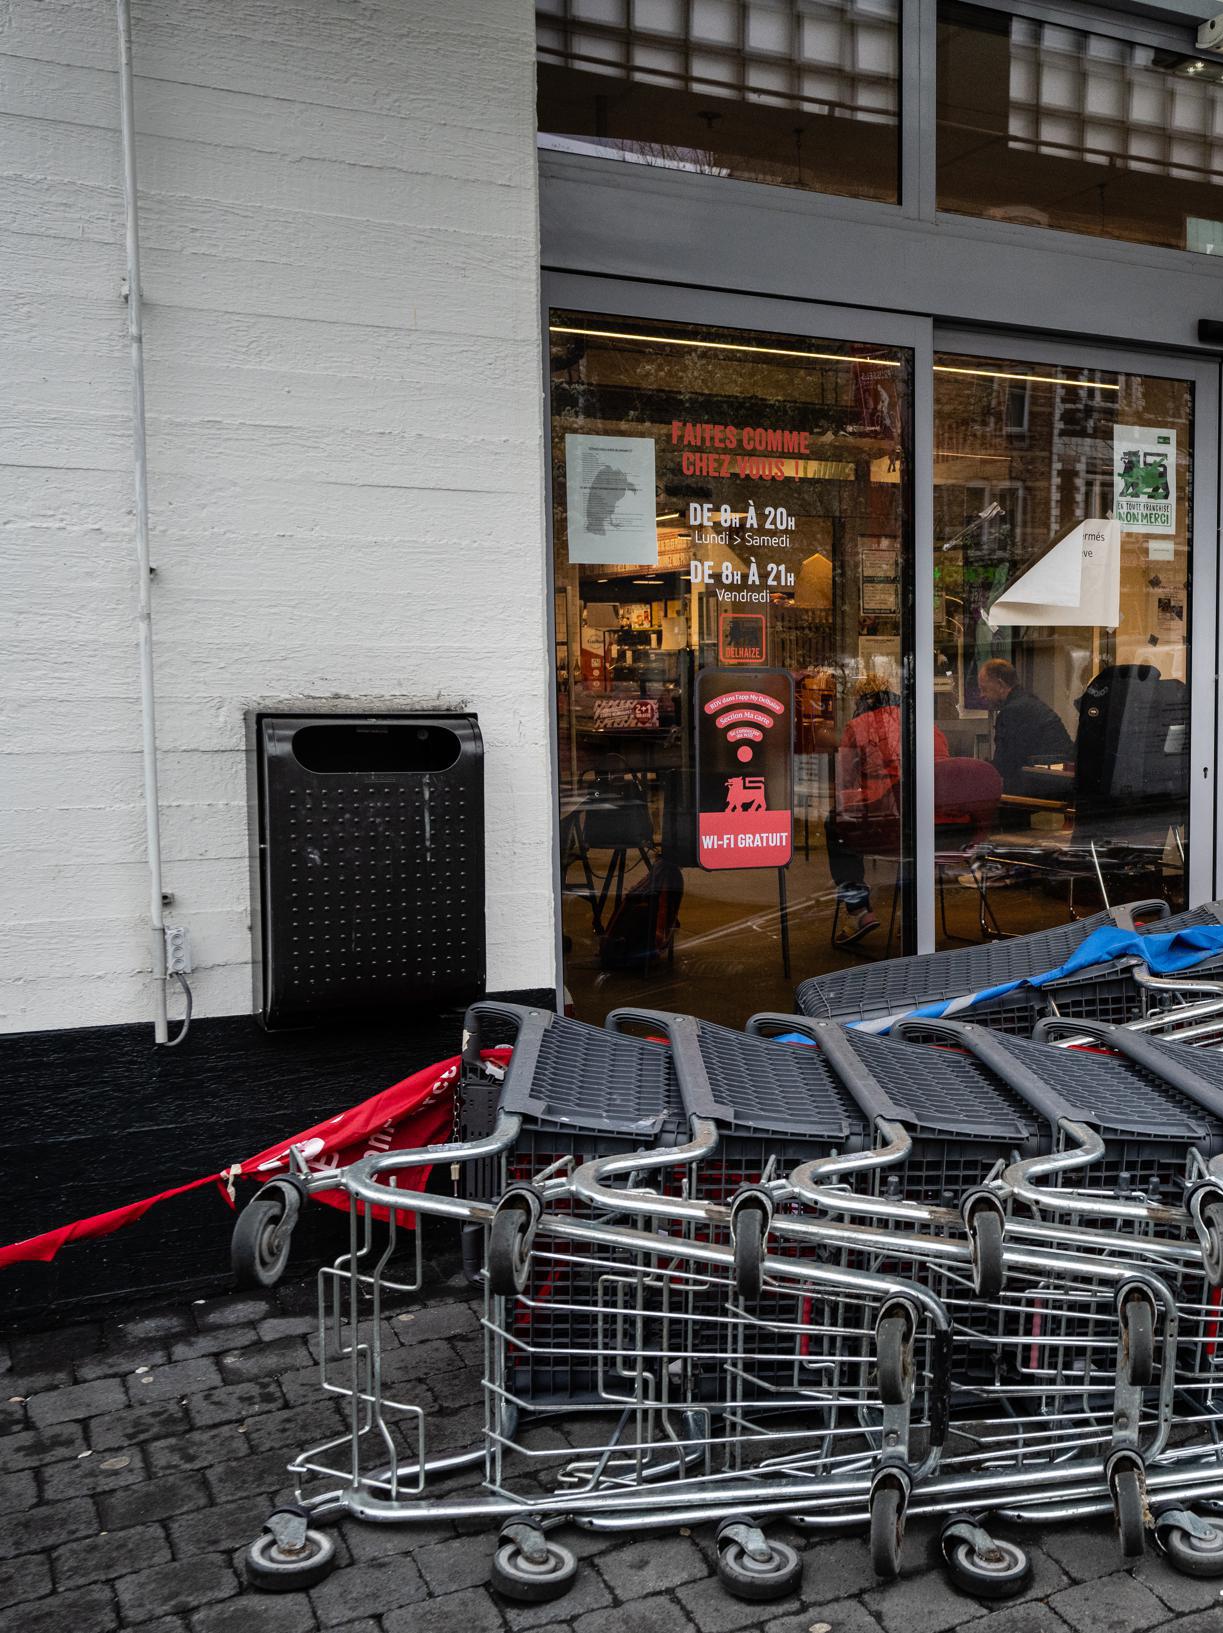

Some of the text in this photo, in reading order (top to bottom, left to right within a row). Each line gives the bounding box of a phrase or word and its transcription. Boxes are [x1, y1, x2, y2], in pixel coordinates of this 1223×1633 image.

[672, 420, 810, 454] FAITES COMME
[682, 451, 730, 479] CHEZ
[738, 455, 785, 481] VOUS
[690, 503, 714, 527] DE
[746, 500, 758, 528] À
[1117, 502, 1124, 510] EN
[1143, 504, 1170, 513] FRANCHISE
[1118, 511, 1169, 525] NON MERCI
[695, 530, 729, 545] Lundi
[746, 532, 790, 547] Samedi
[1082, 531, 1105, 542] rmés
[690, 560, 714, 584] DE
[748, 556, 760, 585] À
[716, 588, 771, 603] Vendredi
[725, 647, 760, 658] DELHAIZE
[635, 704, 652, 714] 2+1
[709, 701, 722, 710] RDV
[722, 696, 735, 704] dans
[750, 694, 758, 703] My
[719, 713, 743, 724] Section
[754, 714, 770, 725] carte
[702, 832, 788, 850] WI-FI GRATUIT
